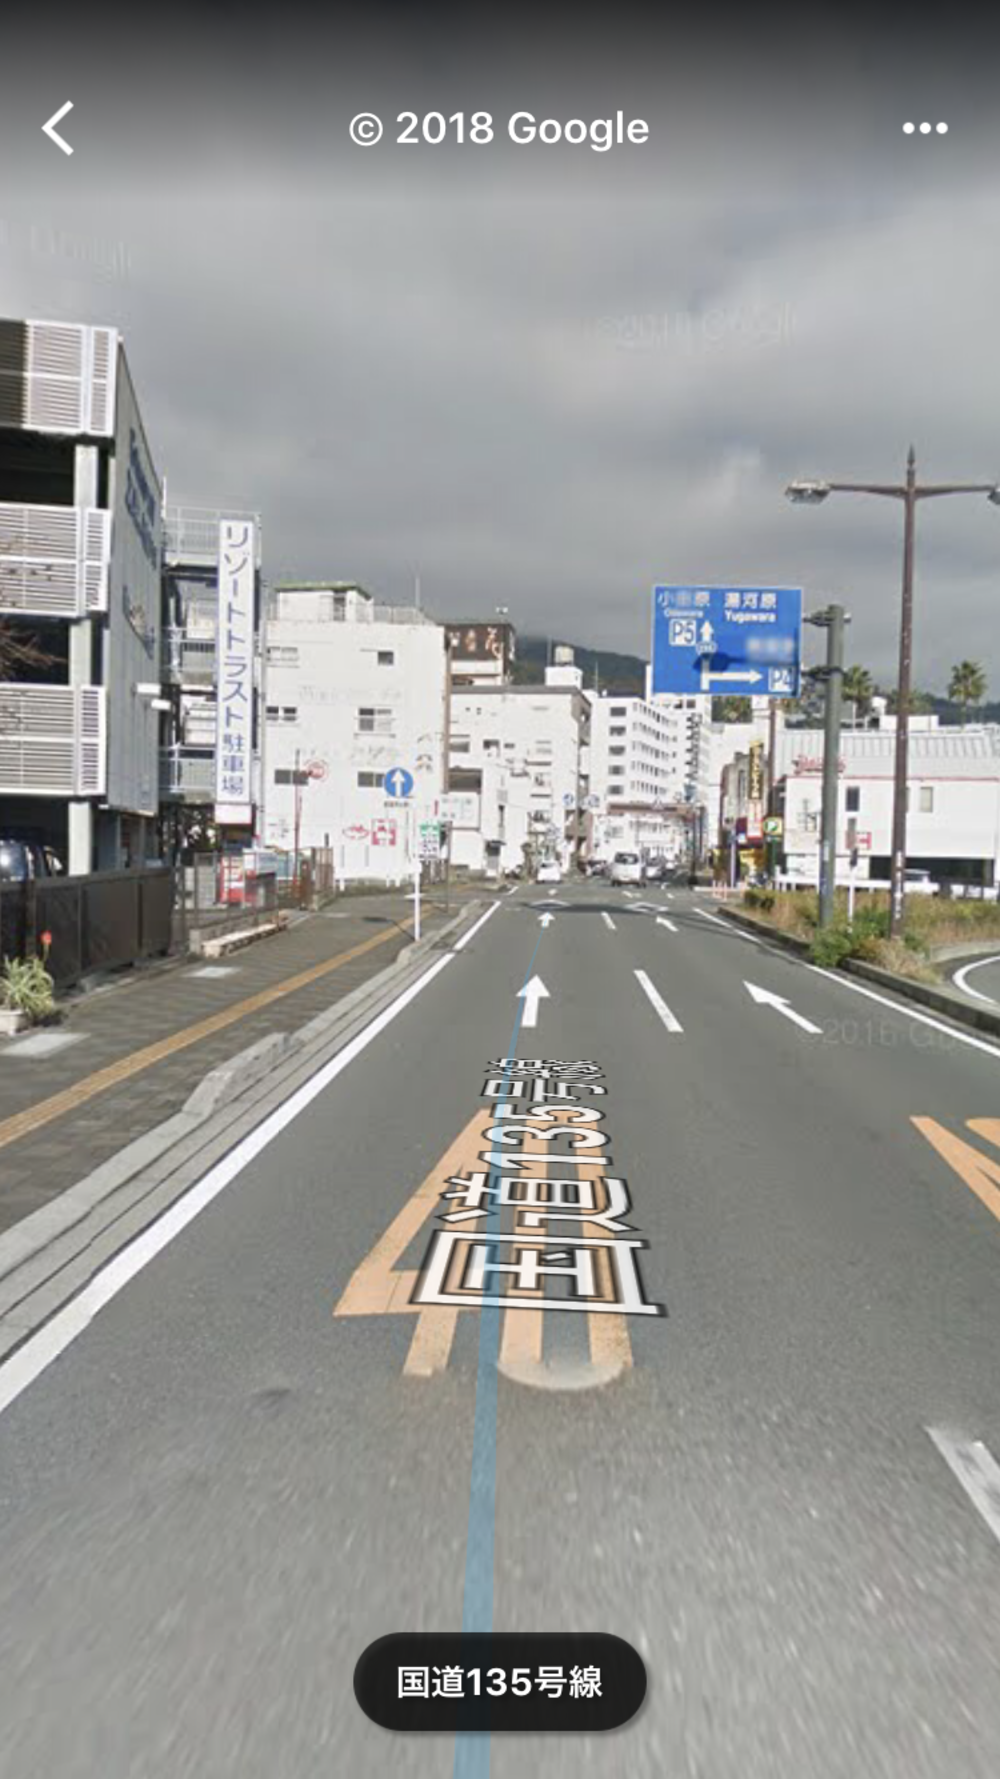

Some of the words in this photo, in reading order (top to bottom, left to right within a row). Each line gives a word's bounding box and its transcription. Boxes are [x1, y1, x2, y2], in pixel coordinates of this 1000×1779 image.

[221, 524, 249, 796] リゾートトラスト駐車場
[672, 621, 695, 645] P5
